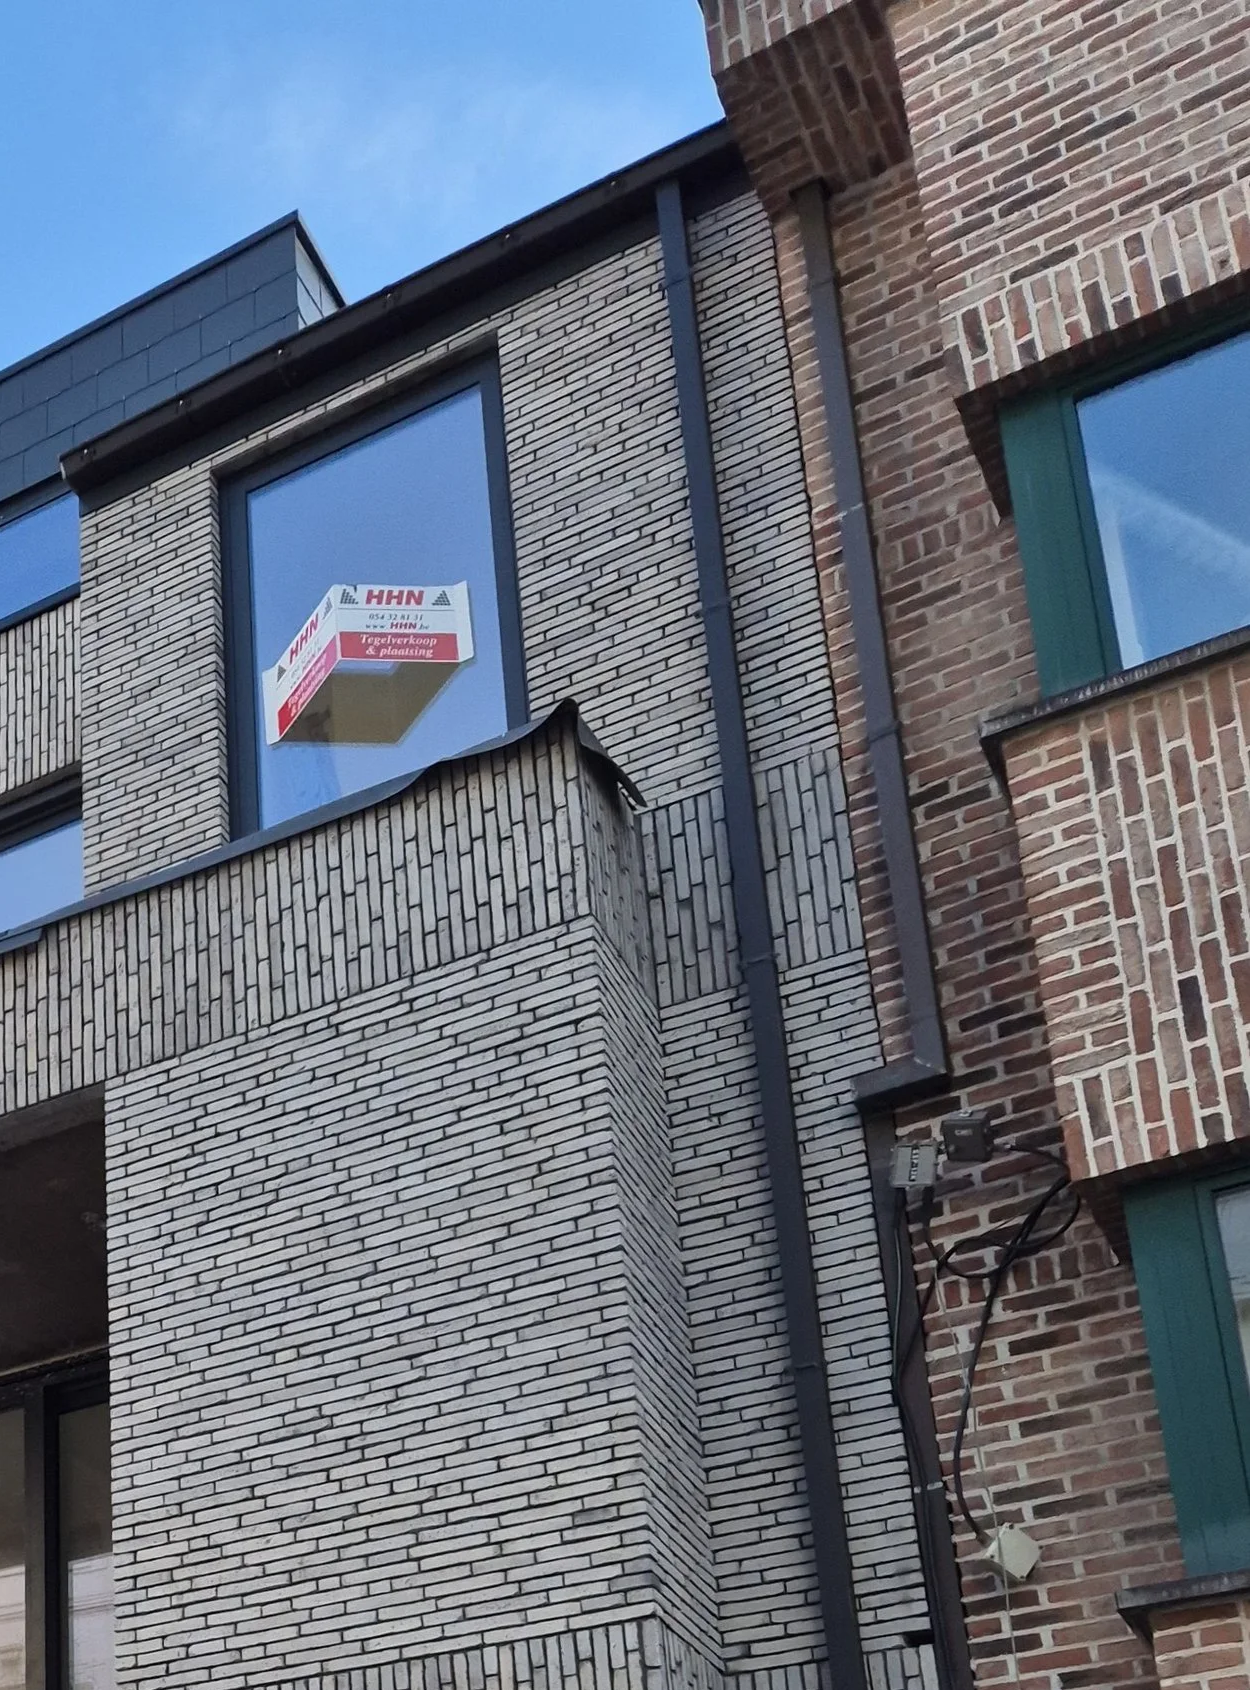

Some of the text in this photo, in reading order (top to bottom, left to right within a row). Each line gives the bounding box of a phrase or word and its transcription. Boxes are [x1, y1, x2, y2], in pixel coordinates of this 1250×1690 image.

[366, 589, 424, 605] HHN
[289, 612, 319, 666] HHN
[360, 634, 437, 646] Tegelverkoop
[365, 646, 434, 658] & plaatsing
